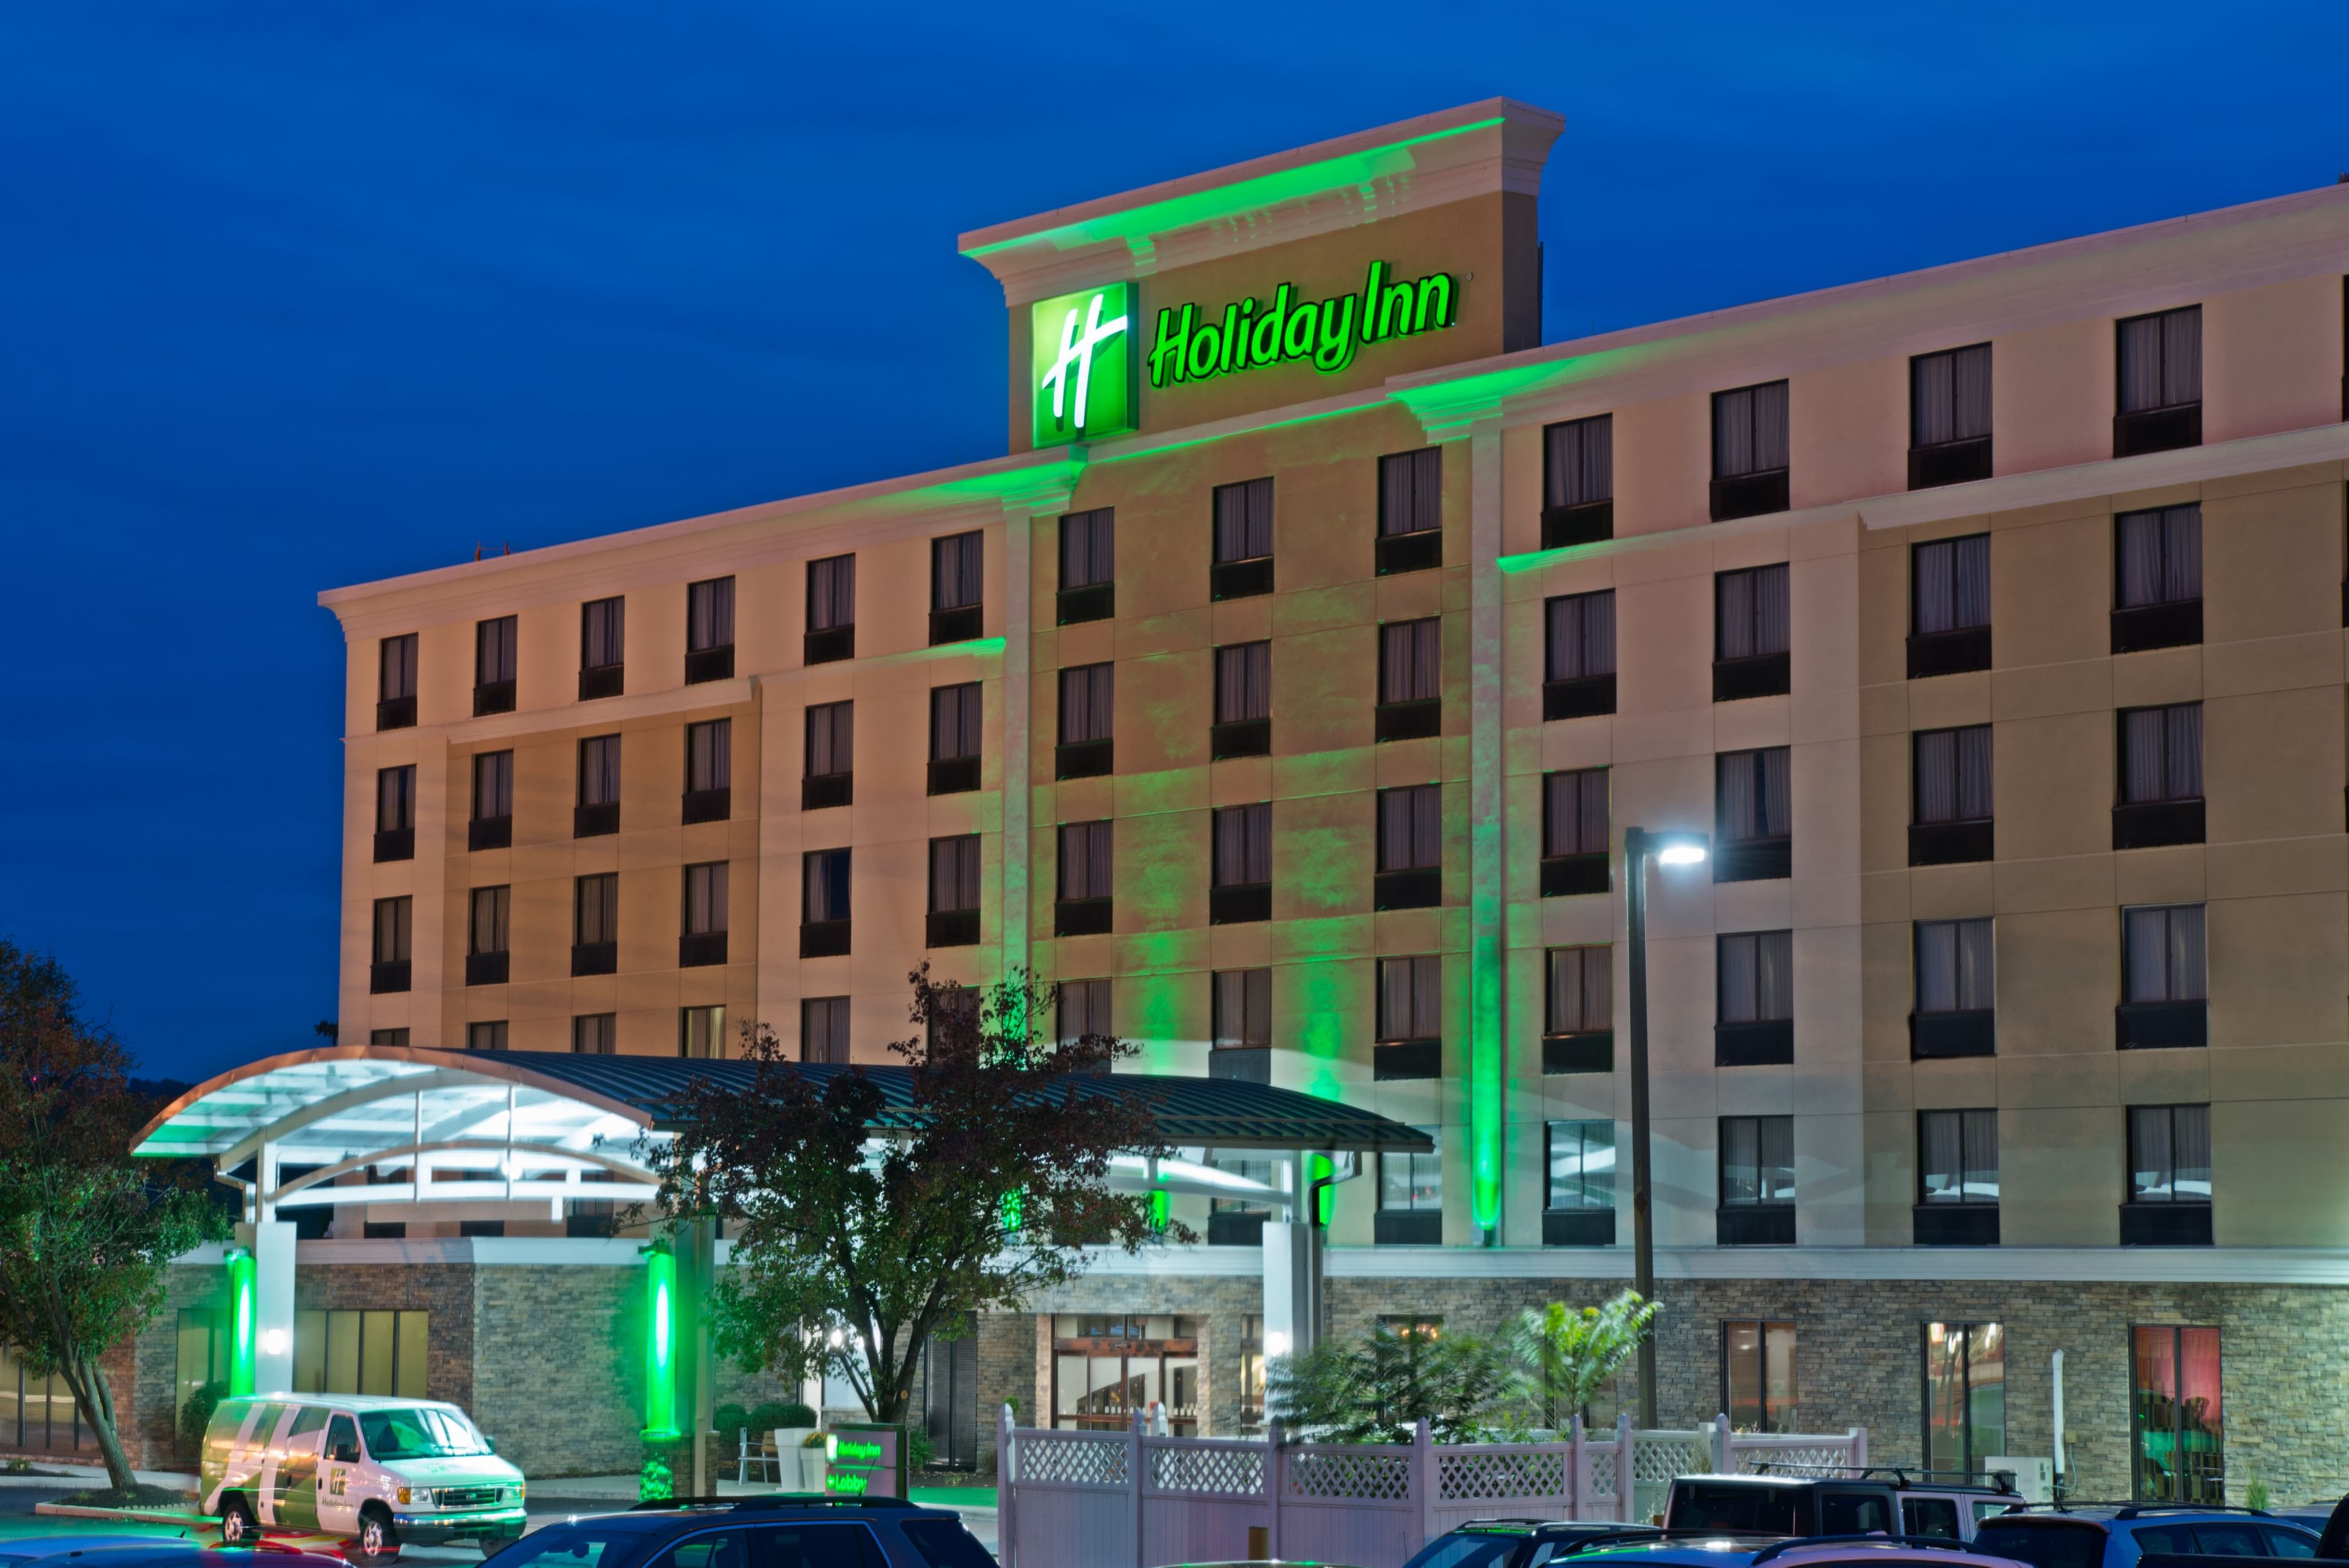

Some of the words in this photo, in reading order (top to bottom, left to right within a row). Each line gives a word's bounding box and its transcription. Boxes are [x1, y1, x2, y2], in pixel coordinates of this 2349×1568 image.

[1147, 281, 1357, 389] Holiday
[1359, 260, 1455, 344] Inn
[838, 1440, 866, 1460] Holiday
[836, 1473, 867, 1495] Lobby
